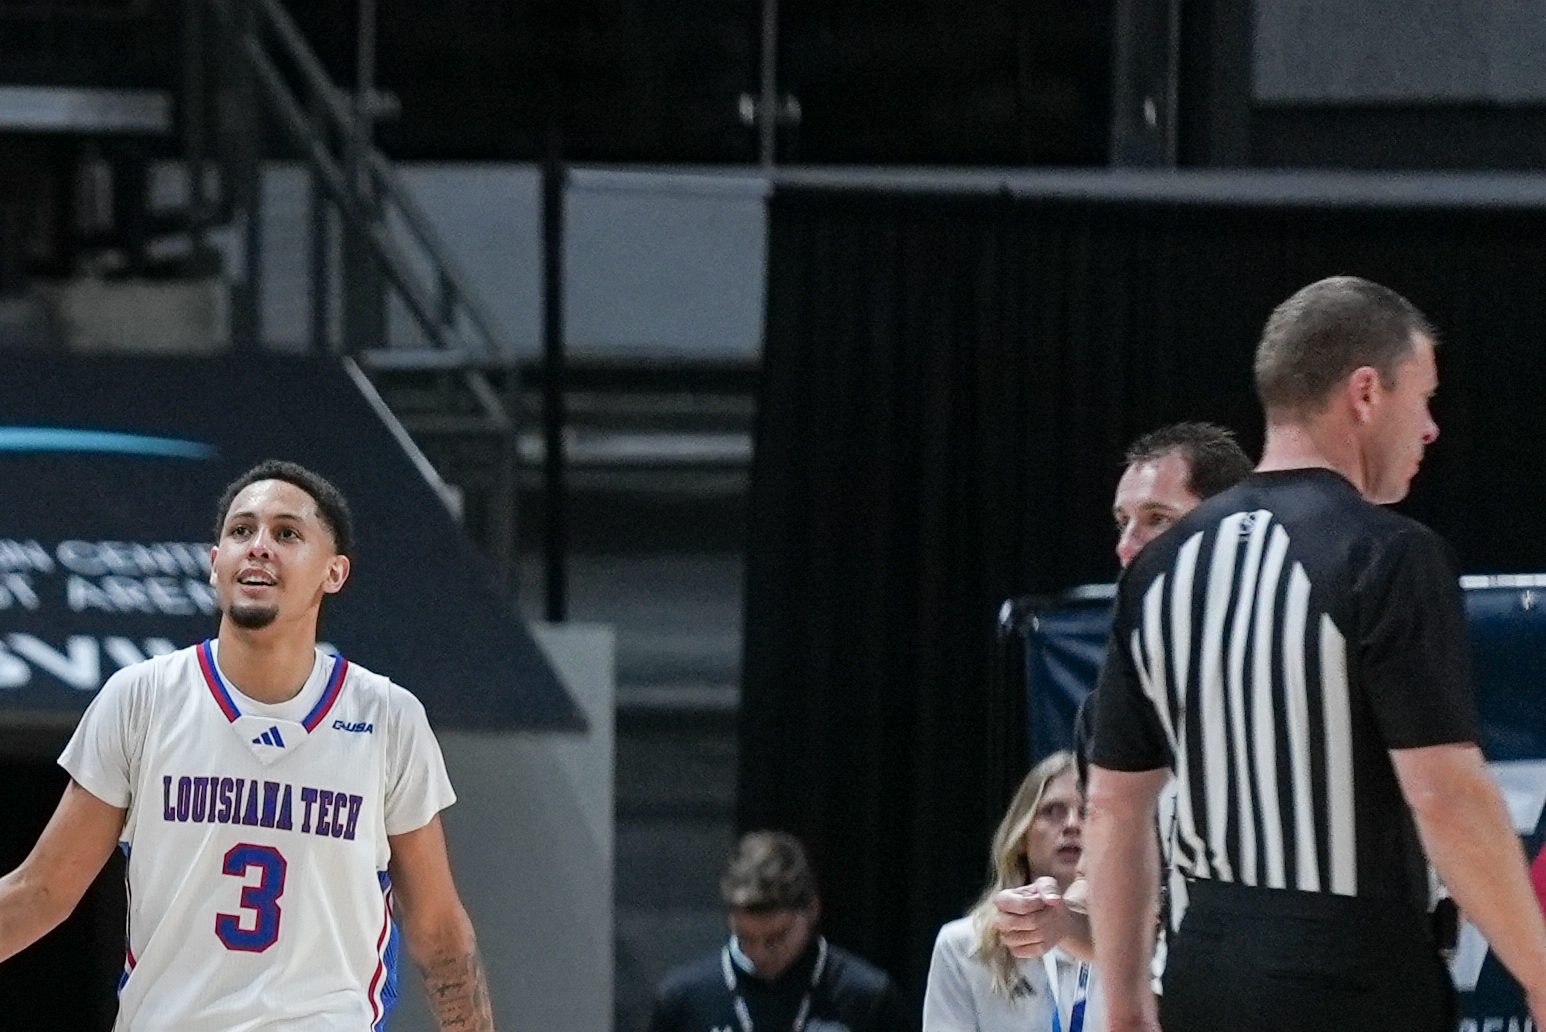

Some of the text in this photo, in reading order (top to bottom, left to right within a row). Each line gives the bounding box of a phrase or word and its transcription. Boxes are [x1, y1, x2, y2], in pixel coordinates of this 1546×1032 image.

[163, 775, 364, 841] LOUISIANA TECH
[215, 842, 288, 953] 3
